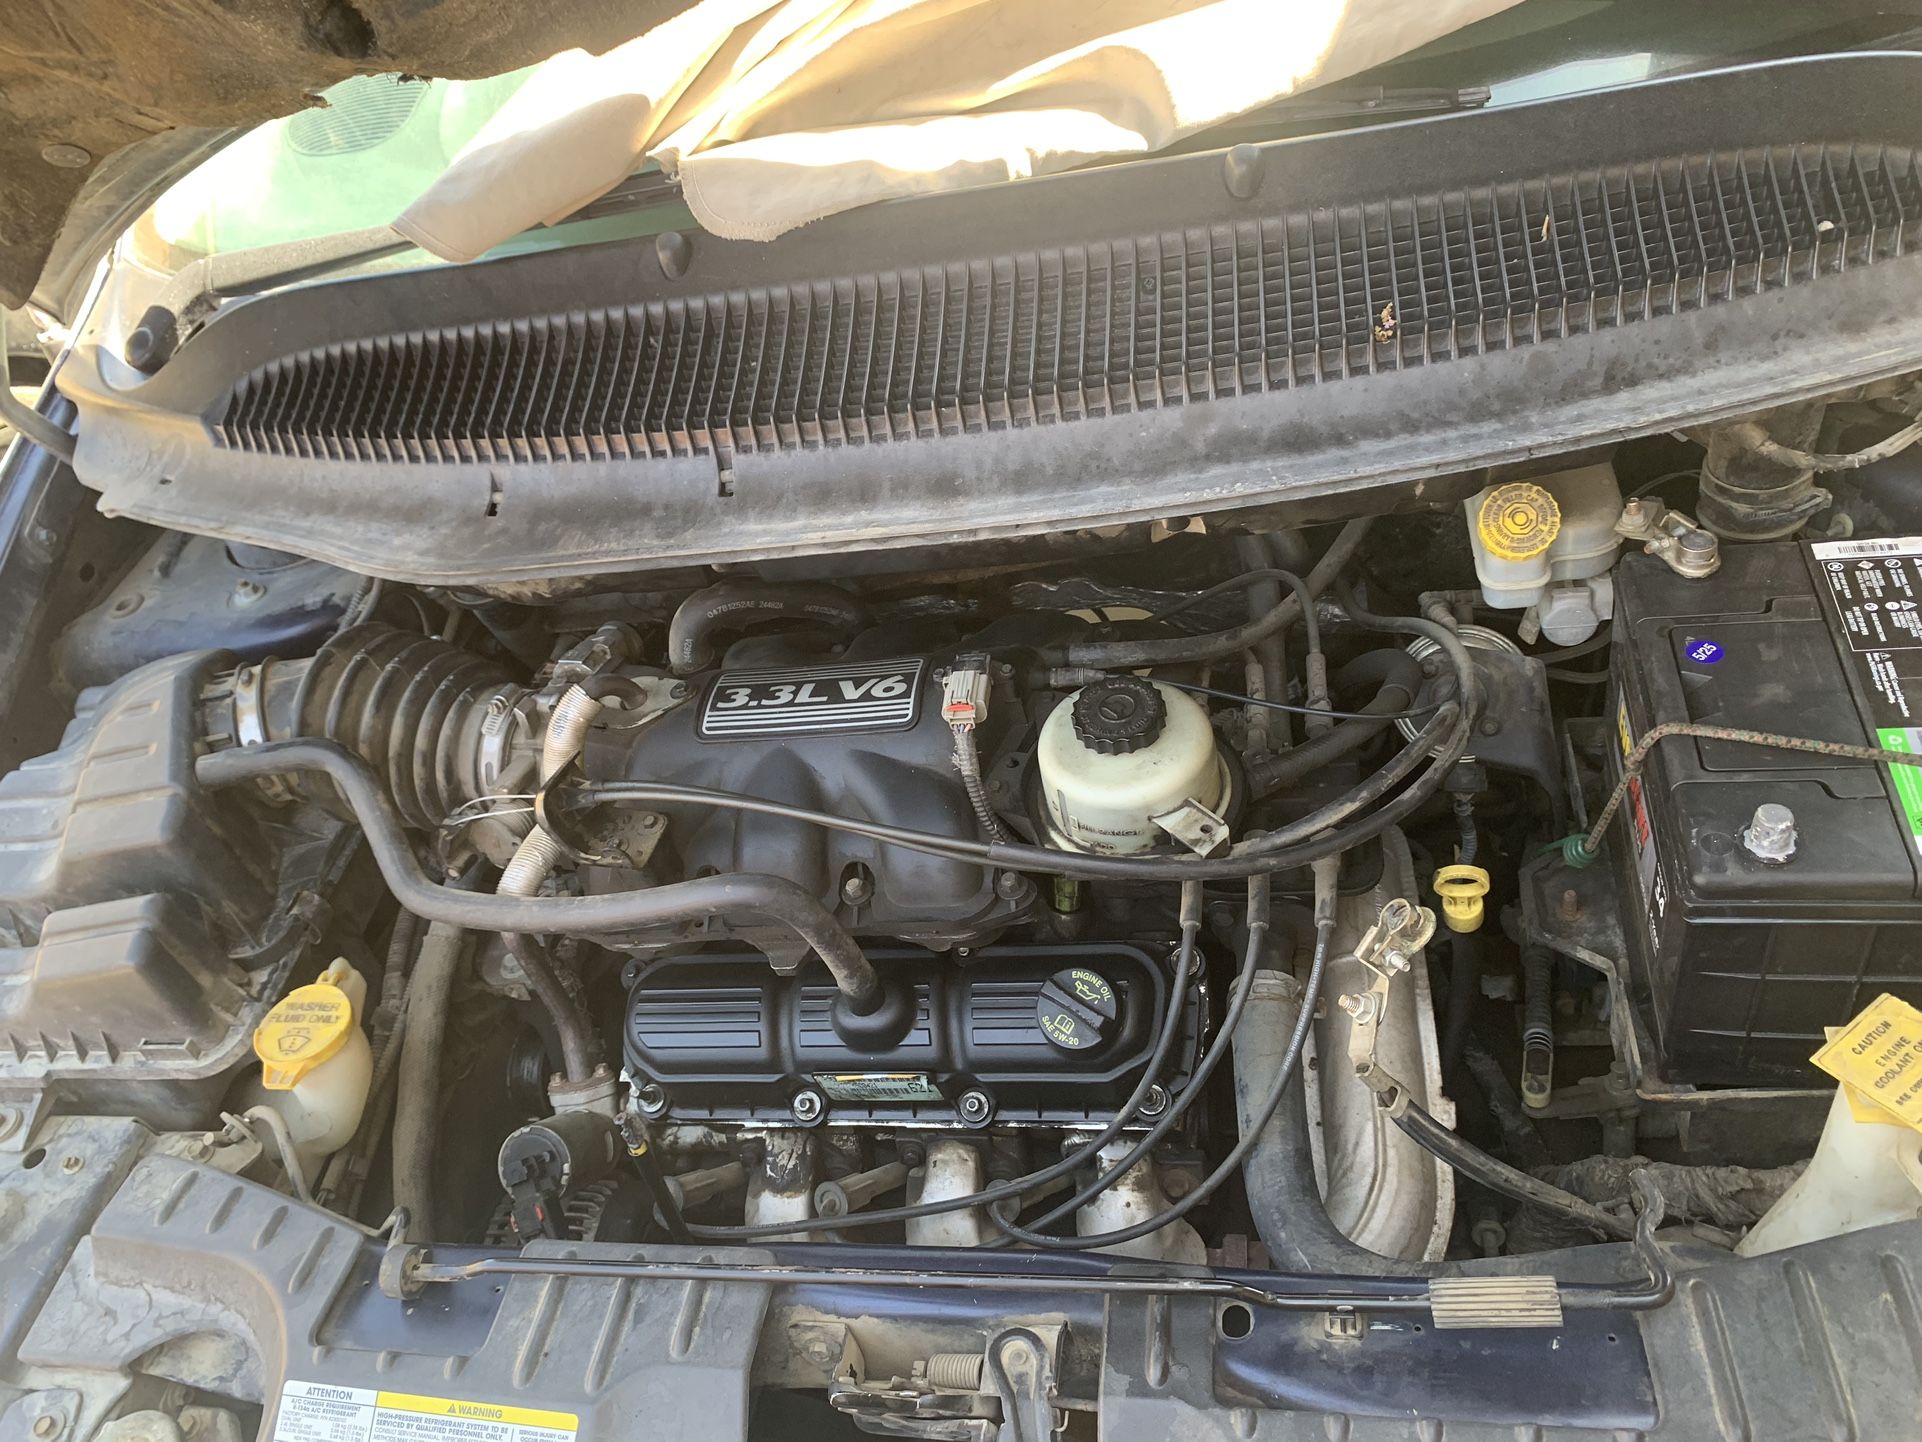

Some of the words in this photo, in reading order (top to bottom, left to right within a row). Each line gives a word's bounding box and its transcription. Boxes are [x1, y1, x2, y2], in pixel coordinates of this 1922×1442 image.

[1692, 643, 1716, 660] 5/25
[716, 683, 828, 708] 3.3L
[838, 675, 908, 700] V6
[1072, 971, 1103, 987] ENGINE
[1100, 986, 1111, 1002] OIL
[1042, 1016, 1055, 1032] SAE
[1053, 1031, 1079, 1045] 5W-20
[1852, 1020, 1892, 1055] CAUTION
[1875, 1036, 1911, 1067] ENGINE
[1874, 1052, 1914, 1089] COOLANT
[306, 1386, 352, 1400] ATTENTION
[377, 1412, 422, 1423] HIGH-PRESSURE
[424, 1418, 464, 1428] REFRIGERANT
[466, 1423, 489, 1432] SYSTEM
[458, 1404, 503, 1419] WARNING
[376, 1419, 404, 1428] SERVICED
[415, 1424, 446, 1434] QUALIFIED
[448, 1428, 483, 1438] PERSONNEL
